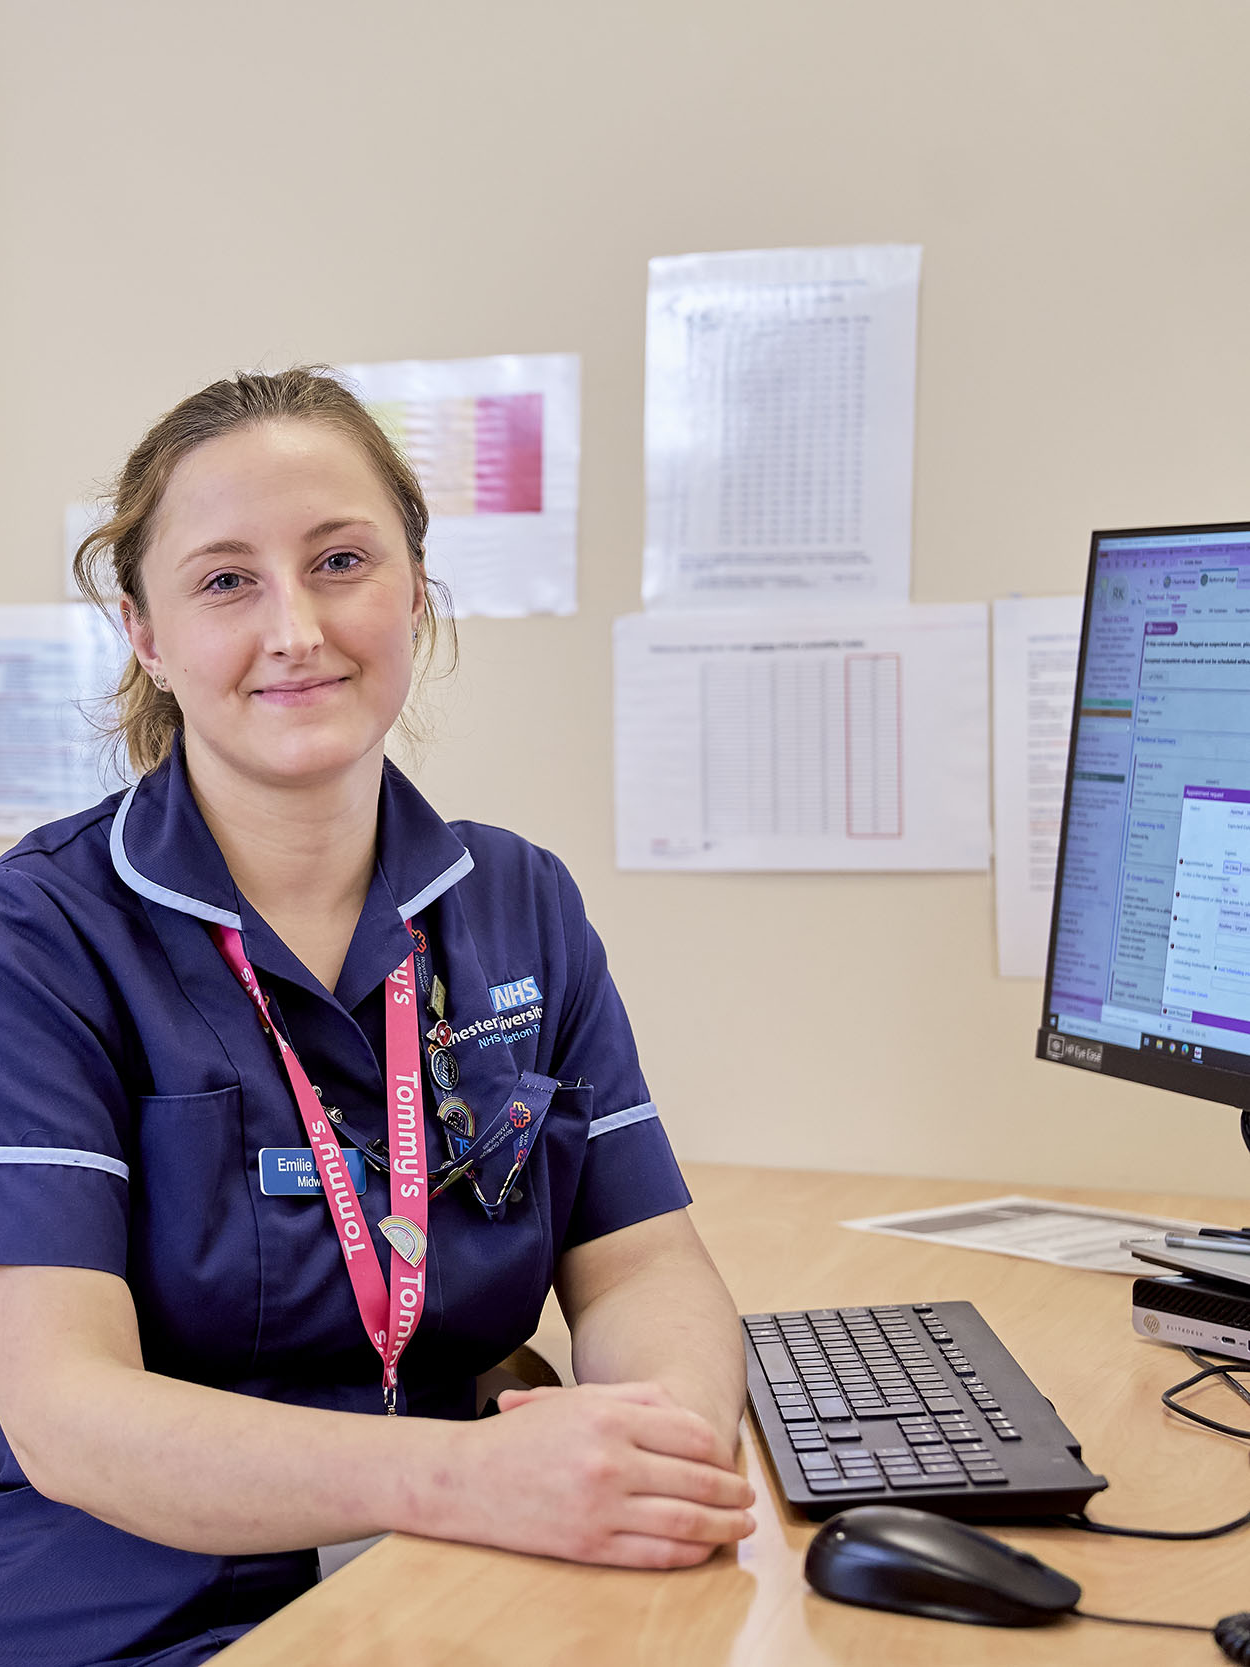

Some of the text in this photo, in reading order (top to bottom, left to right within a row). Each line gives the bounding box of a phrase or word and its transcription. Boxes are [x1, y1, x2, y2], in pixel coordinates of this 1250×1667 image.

[493, 978, 539, 1011] NHS
[448, 1015, 499, 1047] hester
[478, 1032, 502, 1050] NHS
[1074, 1045, 1087, 1058] Eye
[1086, 1048, 1102, 1063] Ease
[395, 1071, 425, 1198] Tommy's
[277, 1158, 312, 1172] Emilie
[297, 1175, 323, 1188] Midw
[311, 1120, 366, 1261] Tommy's
[1166, 1324, 1204, 1338] ELITEDESK
